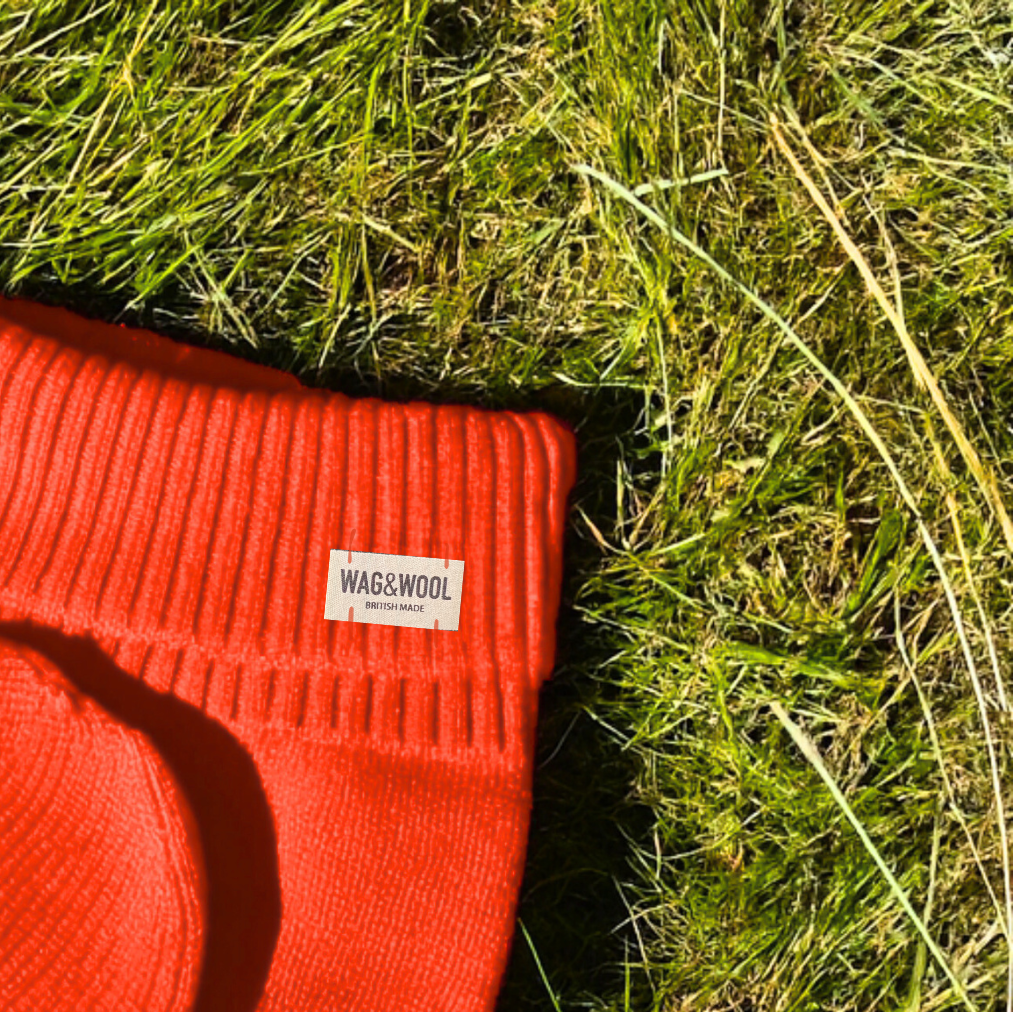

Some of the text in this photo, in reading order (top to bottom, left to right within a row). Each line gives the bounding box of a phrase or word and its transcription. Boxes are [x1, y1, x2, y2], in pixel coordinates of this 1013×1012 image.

[340, 568, 452, 601] WAG&WOOL
[365, 601, 425, 612] BRITISH MADE
